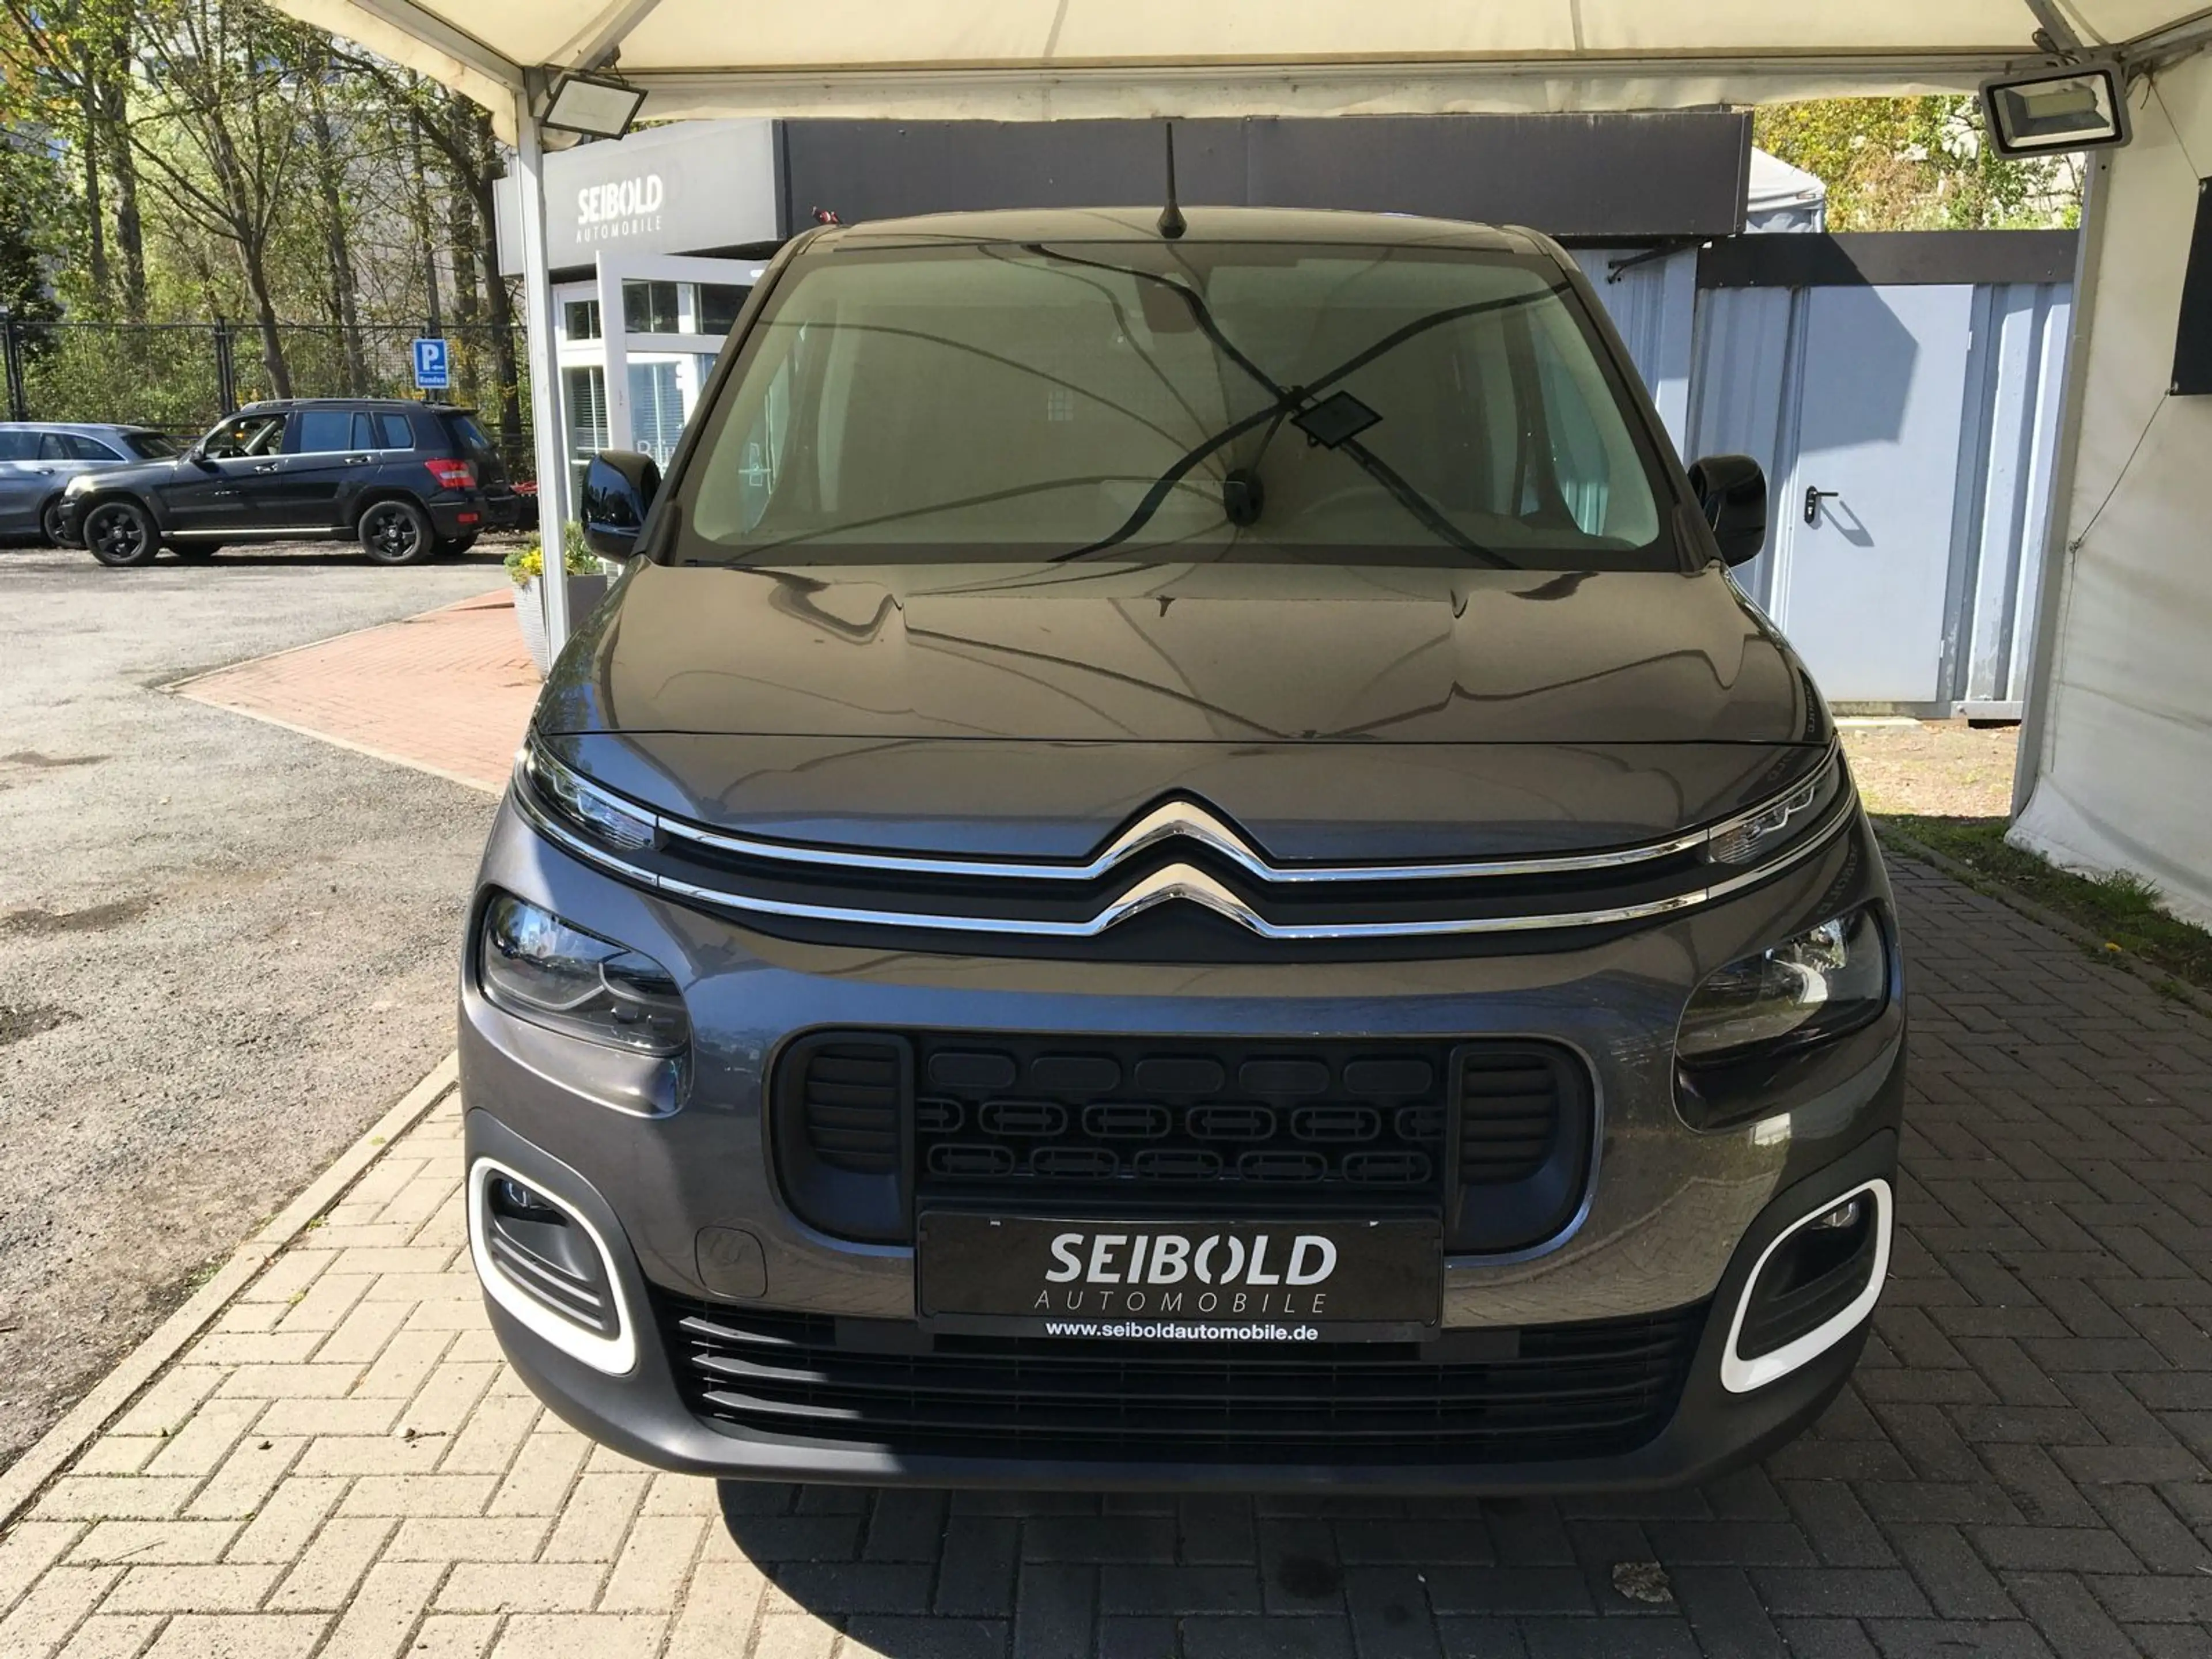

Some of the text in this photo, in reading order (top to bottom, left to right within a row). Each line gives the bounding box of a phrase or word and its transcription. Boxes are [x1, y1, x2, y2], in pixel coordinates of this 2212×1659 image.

[578, 174, 663, 225] SEIBOLD
[576, 215, 662, 244] AUTOMOBILE
[422, 344, 439, 370] P
[1044, 1233, 1337, 1285] SEIBOLD
[1034, 1290, 1327, 1313] AUTOMOBILE
[1046, 1322, 1319, 1341] www.seiboldautomobile.de
